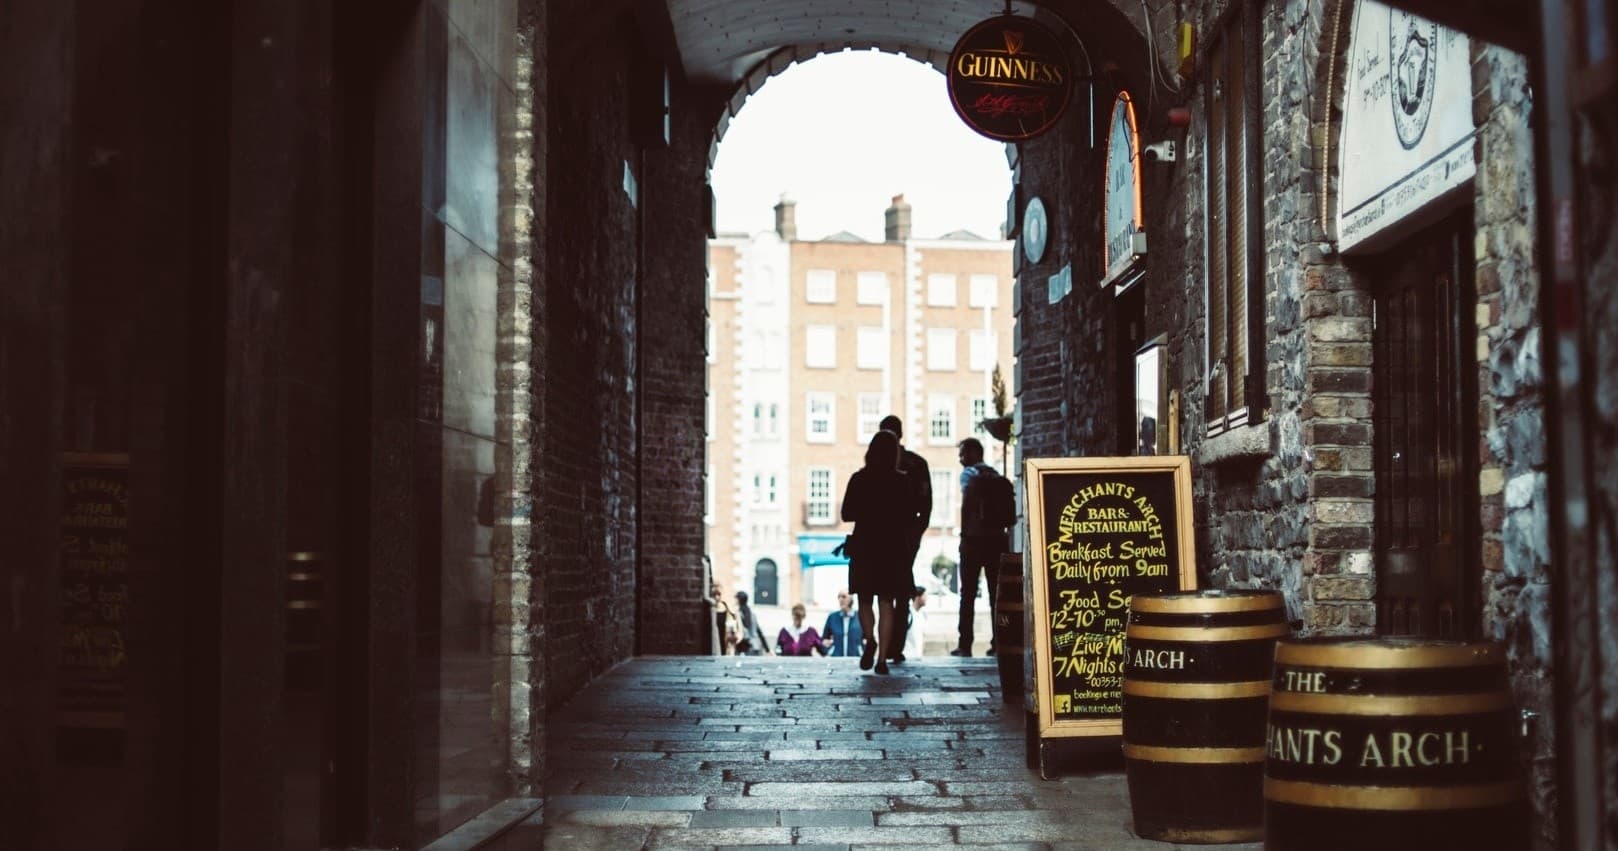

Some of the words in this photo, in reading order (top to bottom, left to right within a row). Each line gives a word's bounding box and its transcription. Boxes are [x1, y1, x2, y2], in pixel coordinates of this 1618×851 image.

[958, 53, 1064, 85] GUINNESS
[1058, 482, 1135, 544] MERCHANTS
[1134, 496, 1163, 540] ARCH
[1073, 520, 1149, 533] RESTAURANT
[1048, 541, 1114, 563] Breakfast
[1120, 541, 1166, 560] Served
[1050, 562, 1090, 584] Daily
[1093, 561, 1129, 581] from
[1135, 559, 1168, 576] 9am
[1060, 589, 1100, 611] Food
[1071, 635, 1104, 656] Live
[1134, 649, 1185, 669] ARCH
[1286, 671, 1326, 692] THE
[1359, 731, 1471, 769] ARCH
